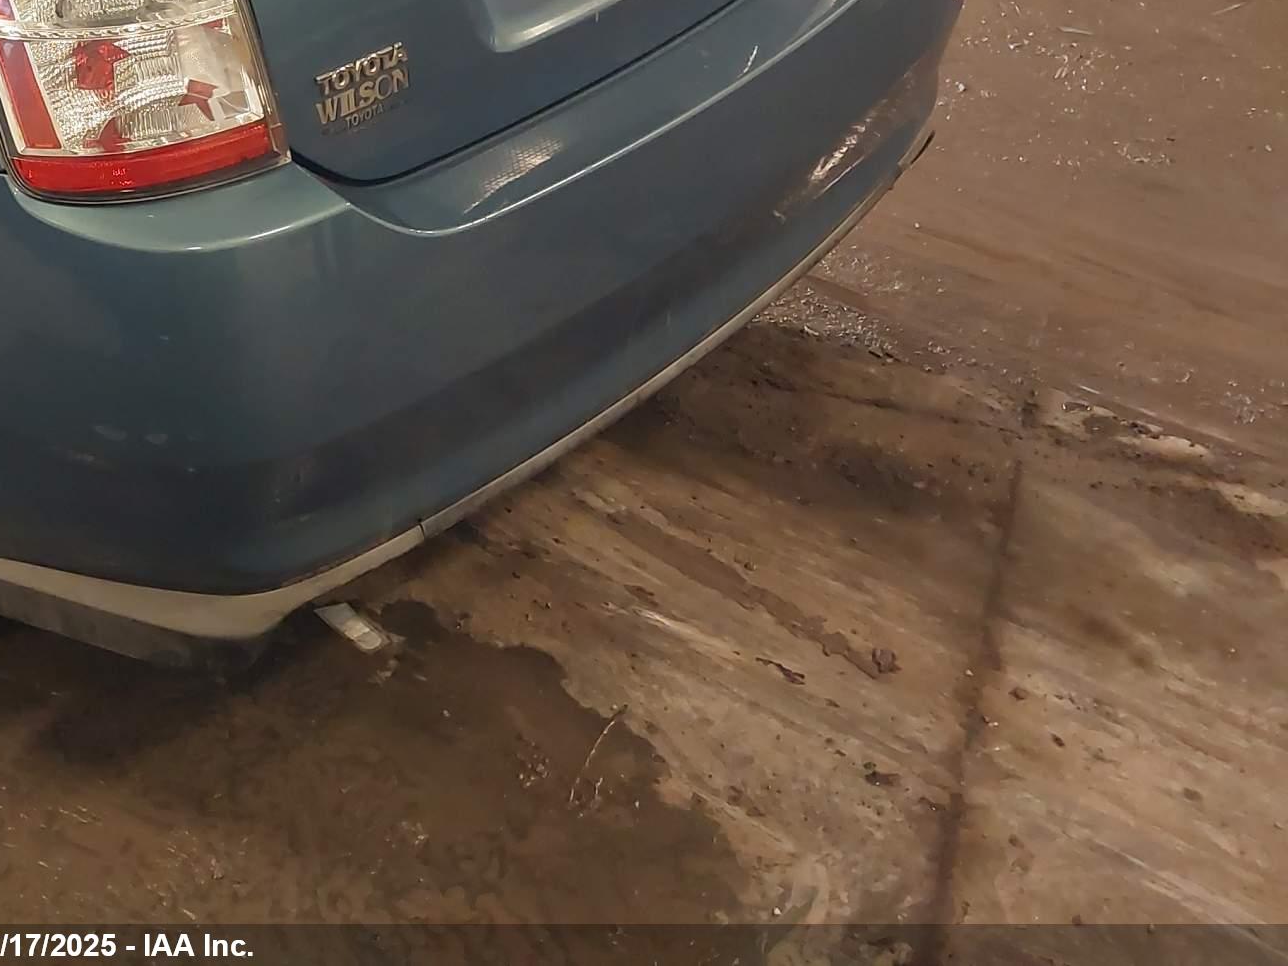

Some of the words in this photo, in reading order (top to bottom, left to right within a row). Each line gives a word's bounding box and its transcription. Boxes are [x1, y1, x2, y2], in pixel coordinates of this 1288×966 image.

[315, 41, 408, 95] TOYOTA
[315, 68, 409, 124] WILSON
[345, 104, 383, 128] TOYOTA
